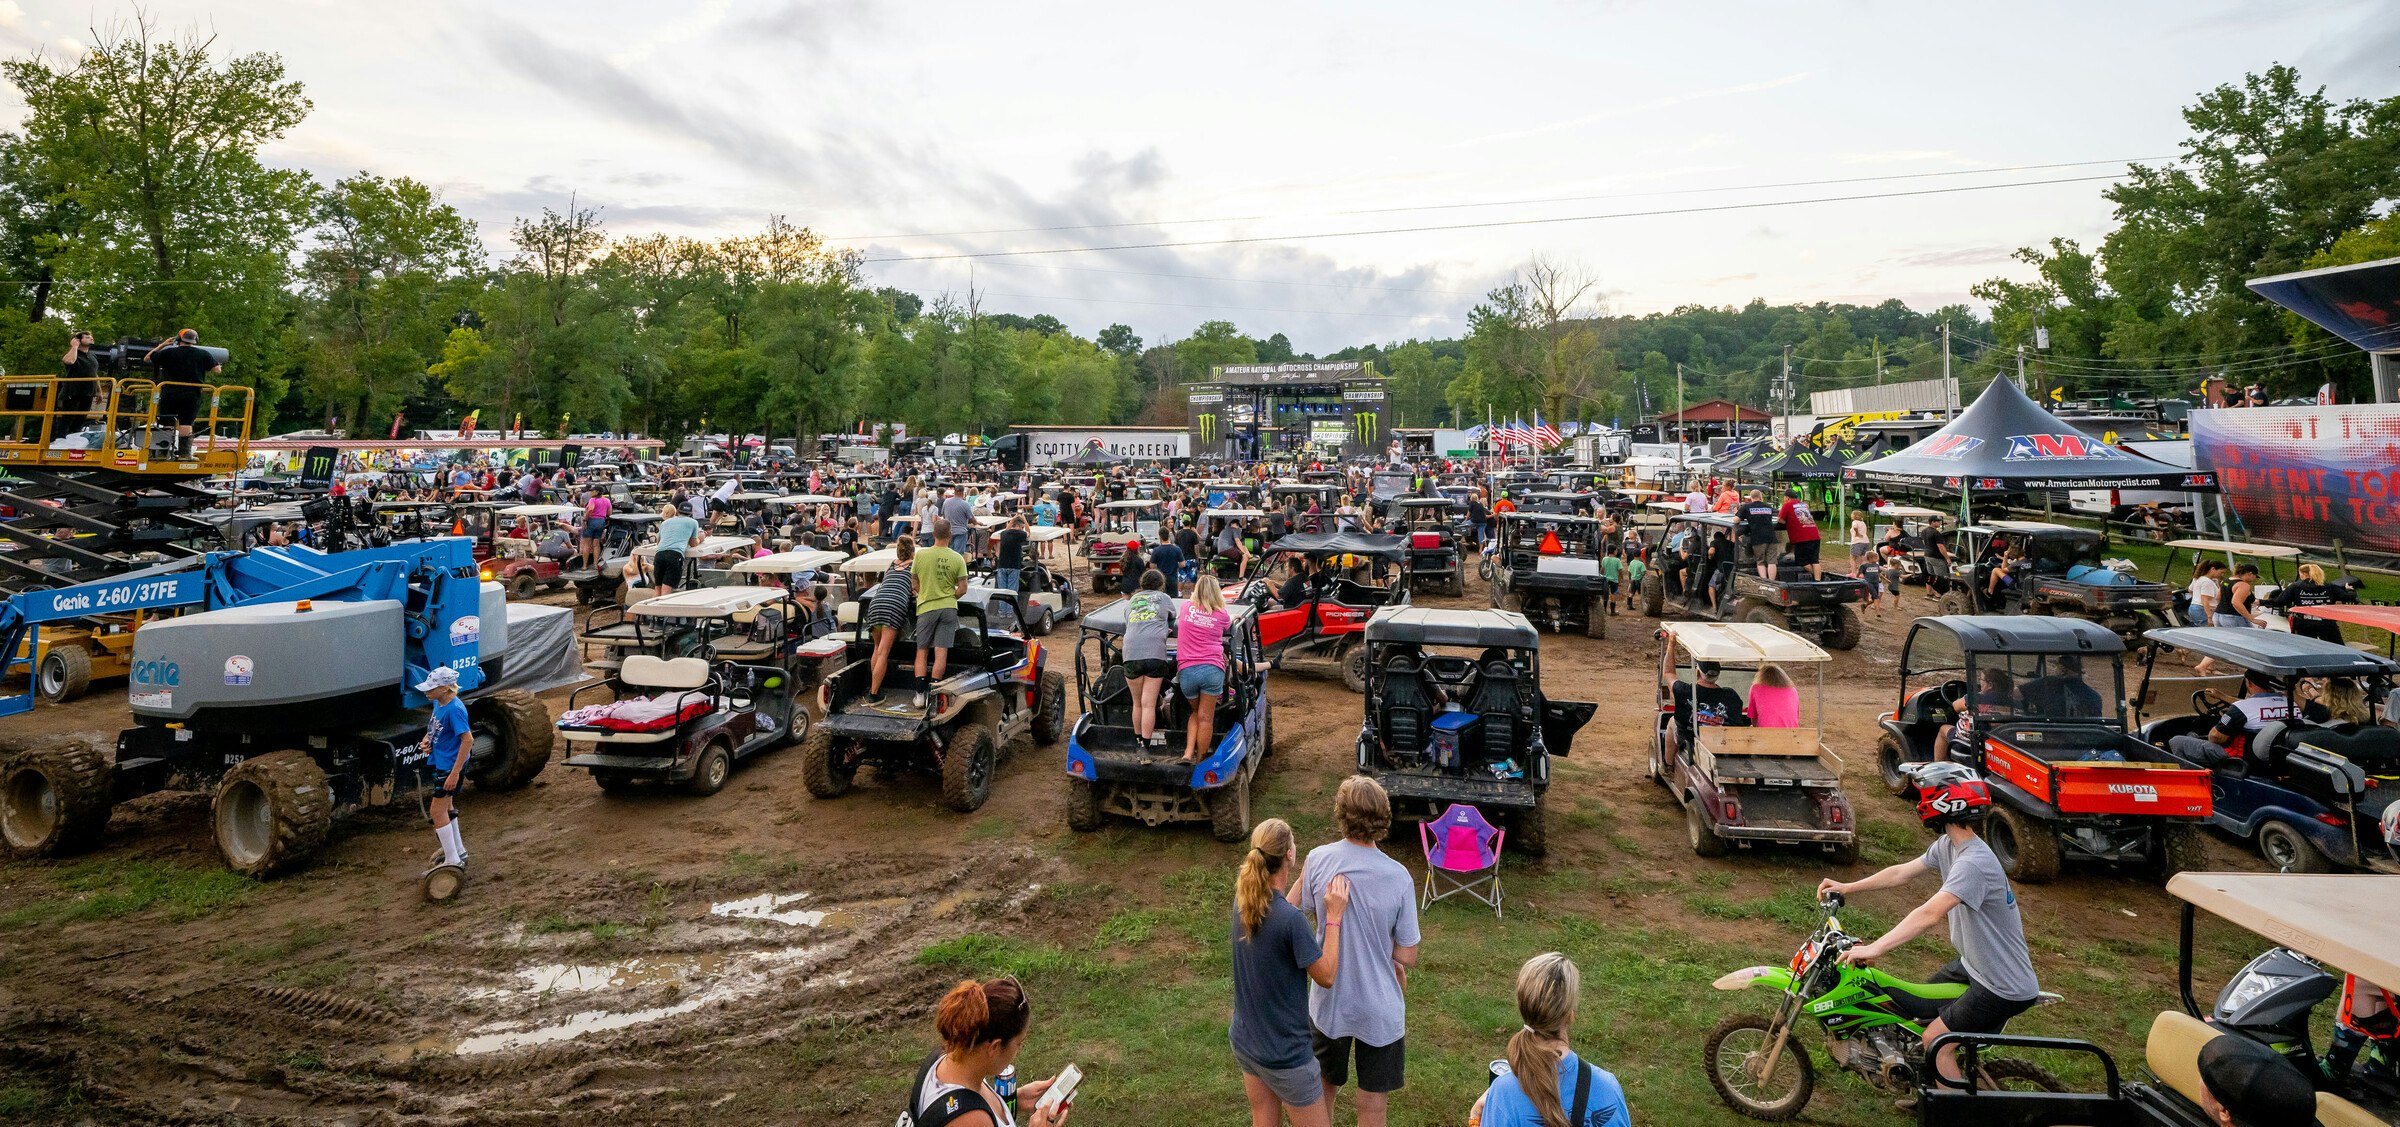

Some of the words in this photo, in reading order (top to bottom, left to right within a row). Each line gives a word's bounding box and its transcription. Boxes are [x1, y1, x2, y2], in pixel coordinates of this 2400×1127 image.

[1226, 366, 1250, 374] AMATEUR
[1251, 365, 1276, 374] NATIONAL
[1278, 363, 1312, 373] MOTOCROSS
[1313, 361, 1359, 371] CHAMPIONSHIP
[1036, 443, 1080, 455] SCOTTY
[1111, 443, 1178, 456] McCREERY
[2002, 434, 2128, 460] AMA
[1865, 473, 1933, 485] www.AmericanMotorcyclist.com
[1972, 479, 2005, 490] AMA
[2024, 478, 2160, 489] www.AmericanMotorcyclist.com
[2181, 475, 2214, 487] AMA
[53, 593, 90, 612] Genie
[97, 580, 178, 607] Z-60/37FE
[452, 656, 477, 670] B252
[1986, 751, 2012, 771] KUBOTA
[2108, 784, 2157, 794] KUBOTA
[1813, 1000, 1833, 1012] BBR
